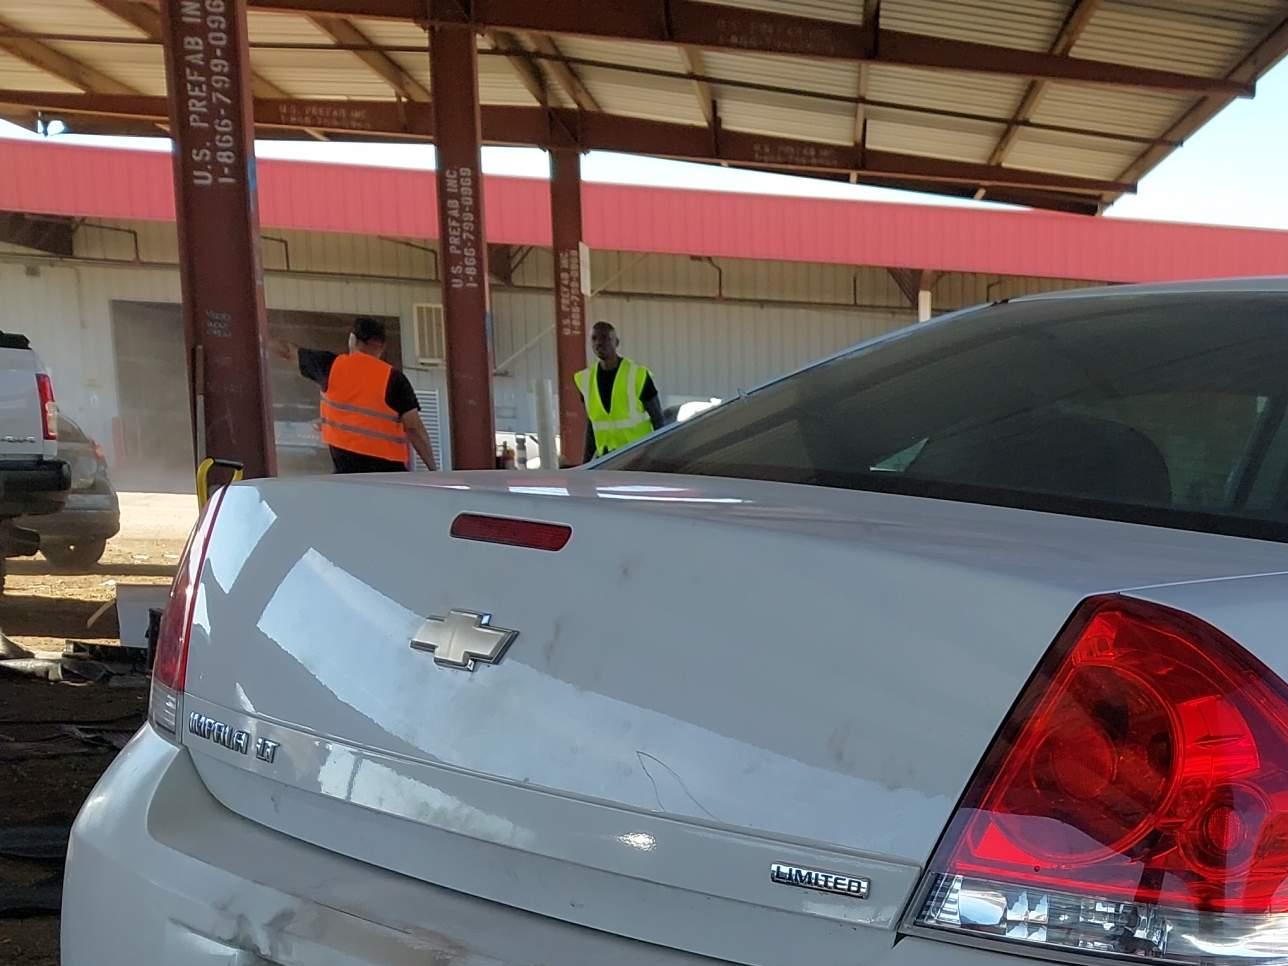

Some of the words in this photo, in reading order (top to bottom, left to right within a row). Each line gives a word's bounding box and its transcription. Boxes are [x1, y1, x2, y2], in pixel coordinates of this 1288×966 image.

[183, 36, 209, 127] PREFAB
[192, 142, 213, 185] U.S.
[447, 199, 461, 254] PREFAB
[460, 167, 479, 288] 1-866-799-0969
[189, 711, 250, 755] IMPALA
[774, 864, 862, 894] LIMITED
